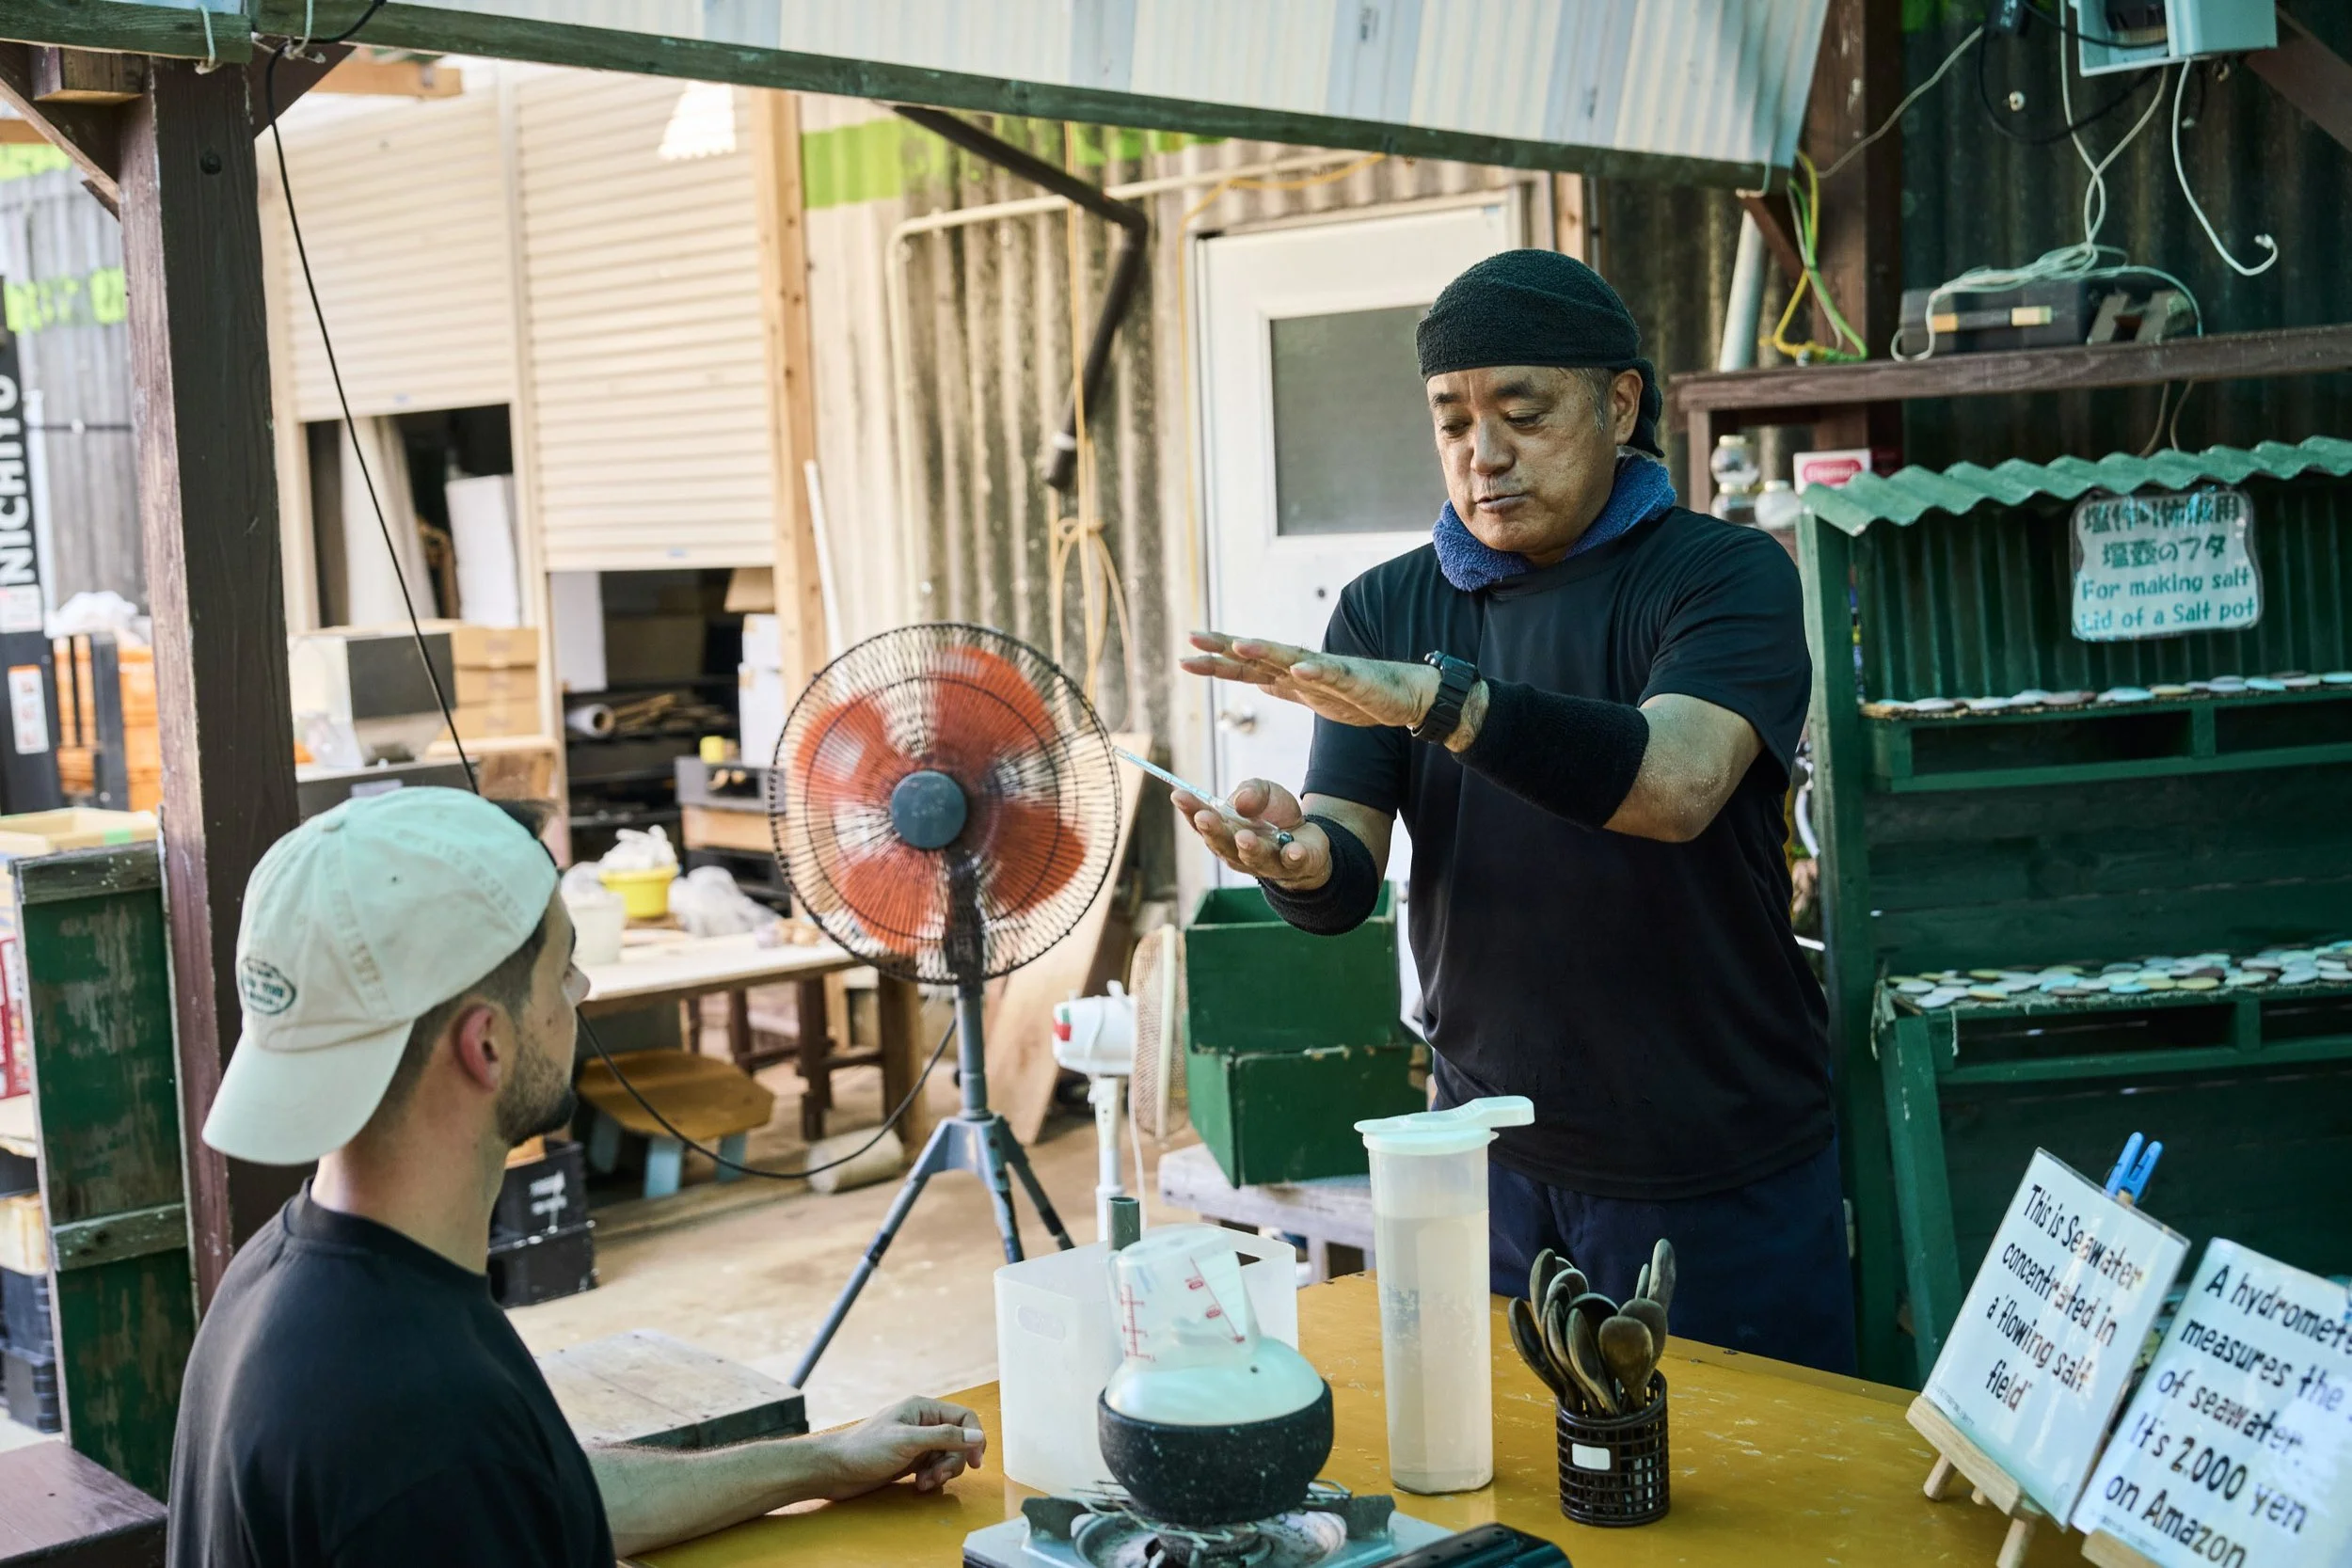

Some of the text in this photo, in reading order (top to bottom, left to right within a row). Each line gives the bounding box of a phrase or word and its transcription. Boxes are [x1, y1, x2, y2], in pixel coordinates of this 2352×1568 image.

[2081, 597, 2255, 632] Lid of a Salt pot
[2082, 567, 2250, 601] For making salt
[2024, 1183, 2142, 1291] This is Seawater
[2204, 1264, 2230, 1298] A
[2002, 1243, 2117, 1347] concentrated in
[1986, 1296, 1999, 1319] a
[2052, 1352, 2092, 1393] salt
[2157, 1370, 2194, 1399] of
[2180, 1319, 2345, 1413] measures the
[2130, 1412, 2170, 1457] It's
[2249, 1481, 2308, 1535] yen
[2106, 1475, 2139, 1512] on
[2141, 1489, 2247, 1568] Amazon
